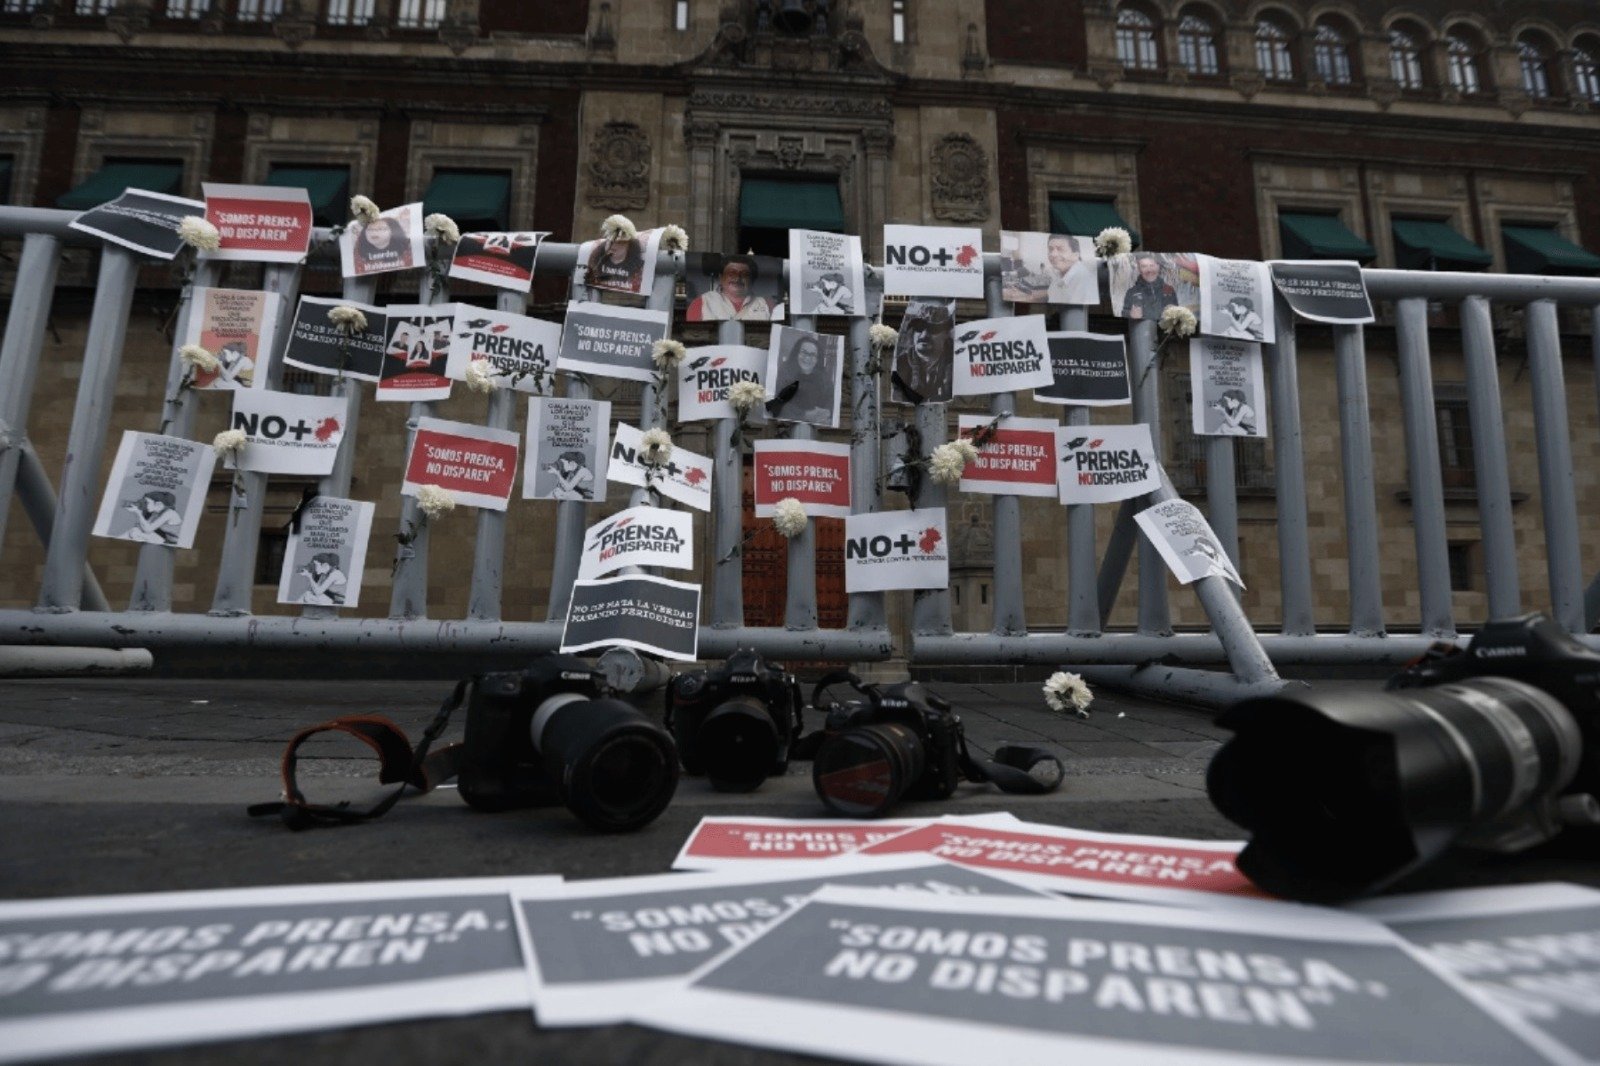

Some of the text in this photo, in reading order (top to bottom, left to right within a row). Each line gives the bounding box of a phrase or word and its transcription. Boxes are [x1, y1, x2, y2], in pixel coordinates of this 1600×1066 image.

[473, 332, 550, 368] PRENSA,
[577, 339, 592, 351] NO
[967, 340, 1044, 363] PRENSA,
[426, 462, 441, 474] NO
[1075, 449, 1149, 471] PRENSA,
[771, 480, 785, 492] NO
[600, 525, 685, 551] PRENSA,
[637, 599, 650, 609] LA
[629, 928, 712, 957] NO
[825, 949, 919, 982] NO
